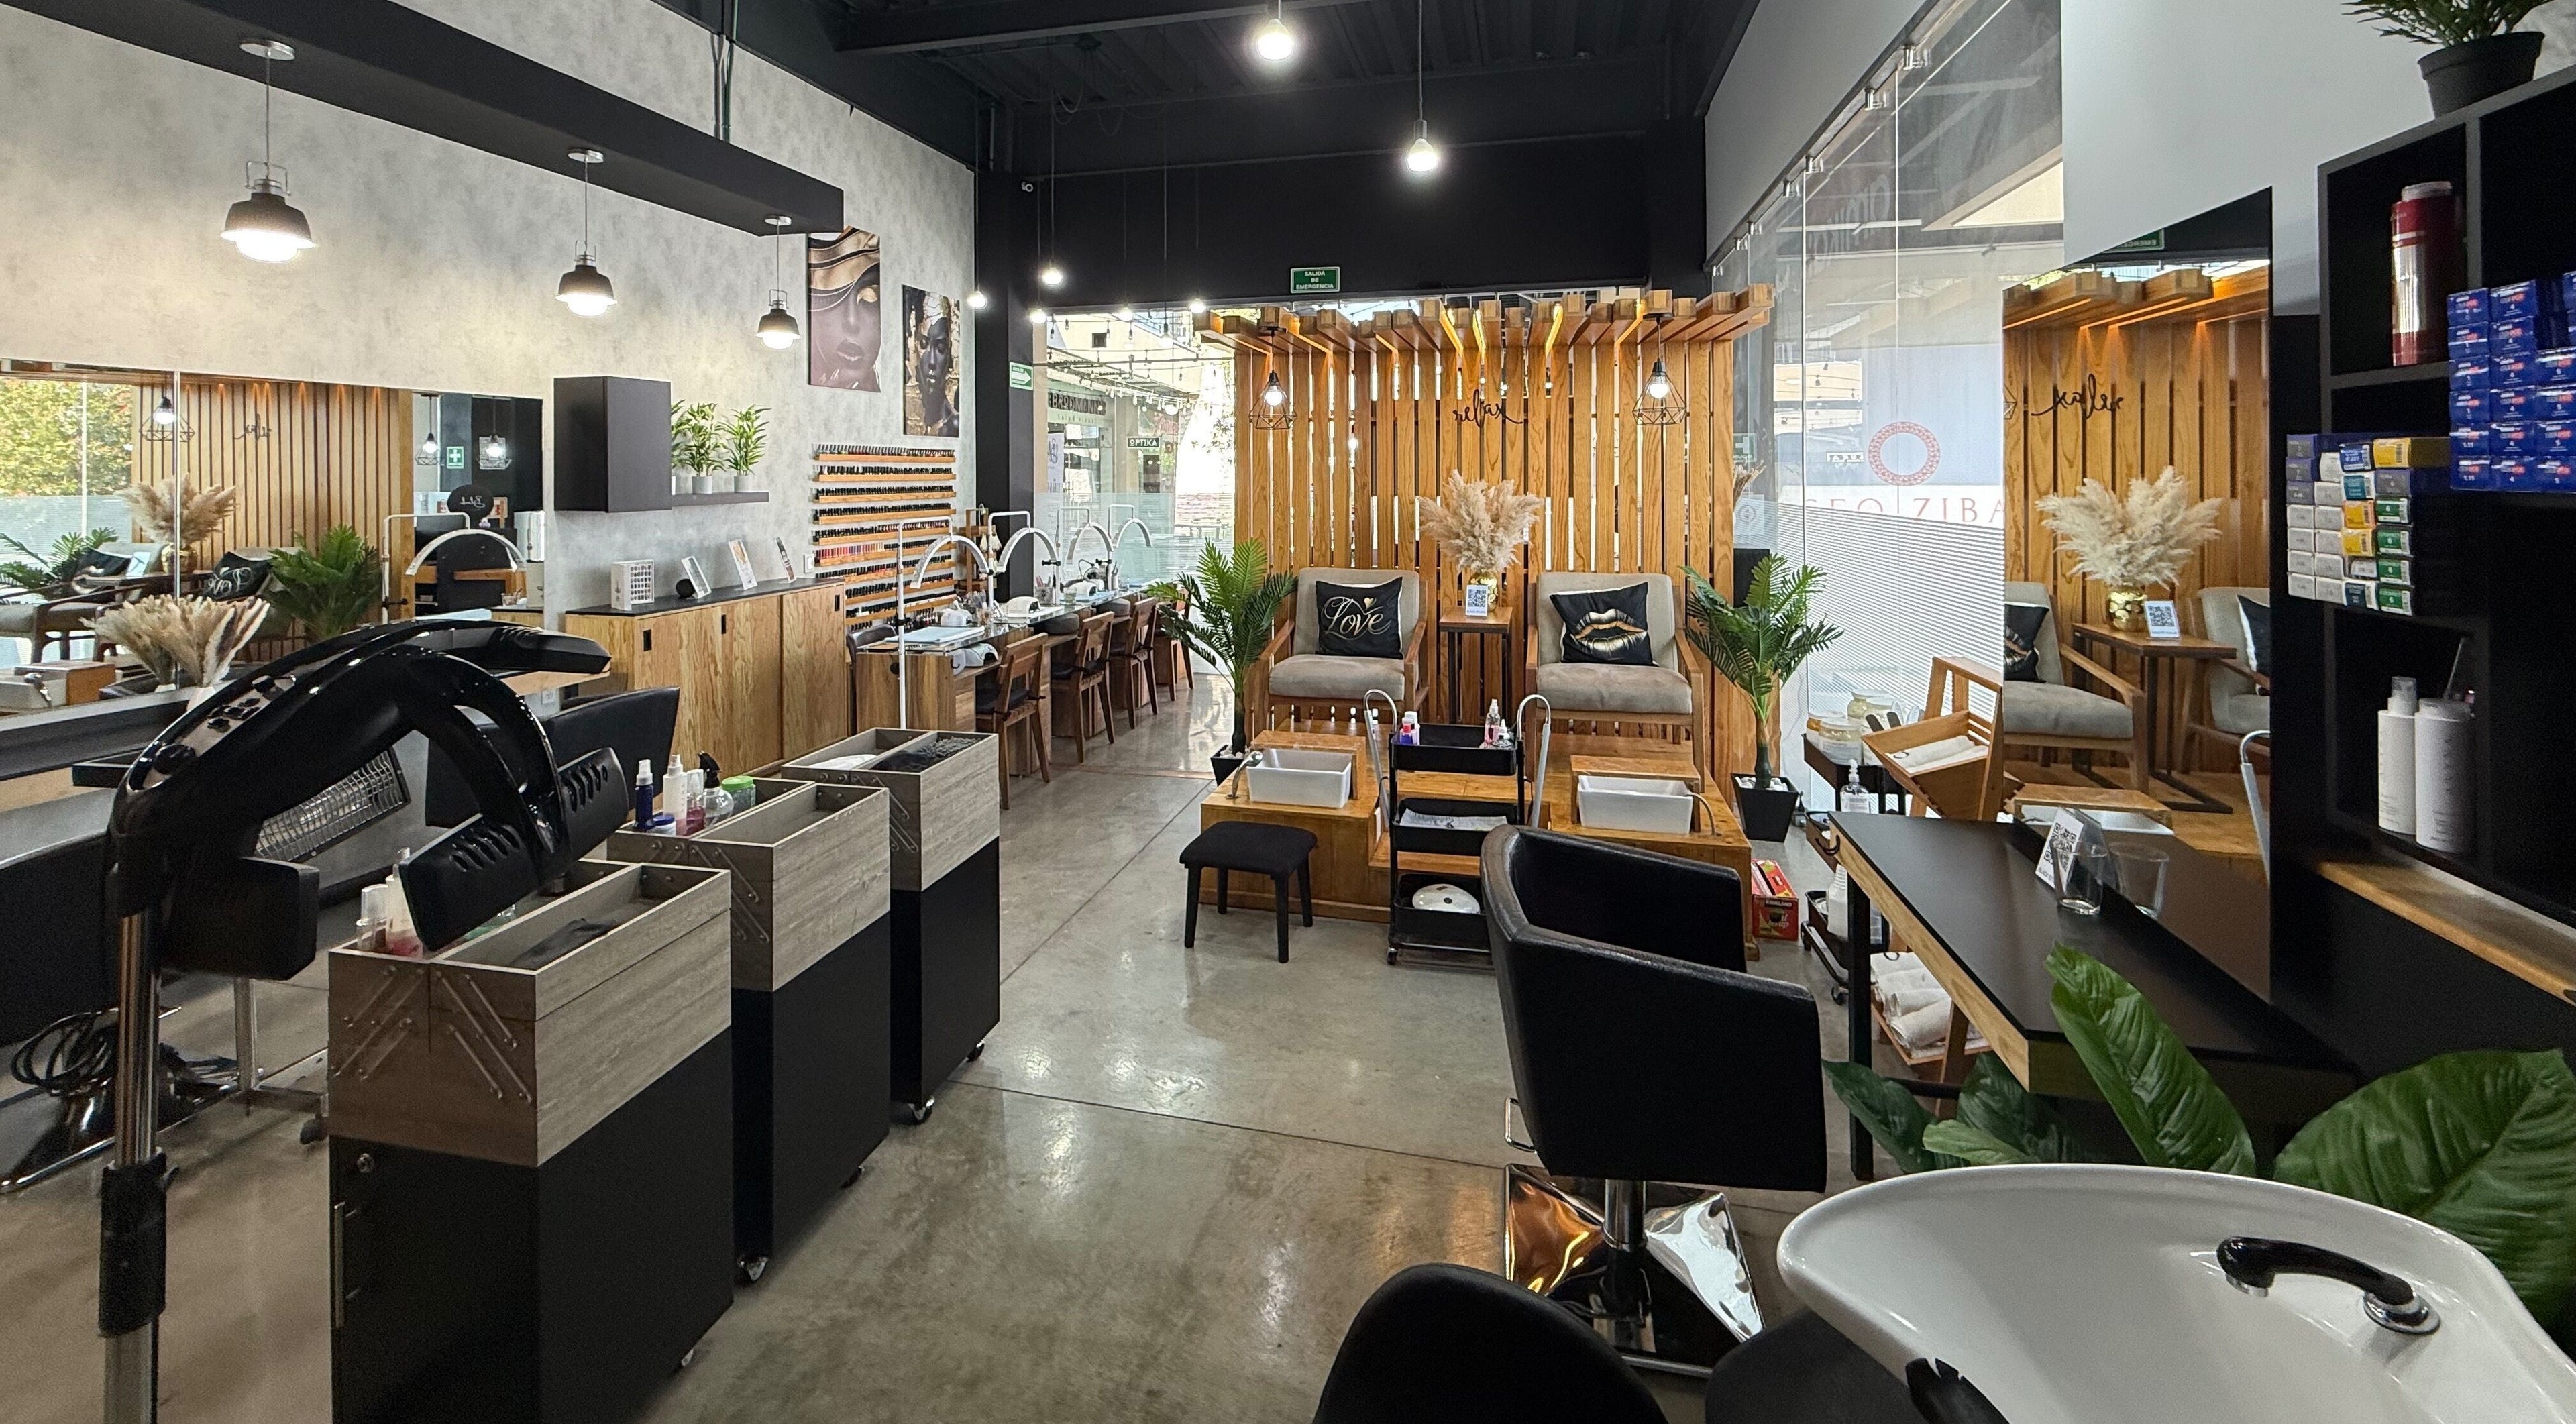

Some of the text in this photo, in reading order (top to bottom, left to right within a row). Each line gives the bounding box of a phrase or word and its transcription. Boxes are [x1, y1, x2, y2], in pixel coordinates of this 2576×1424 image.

[1452, 388, 1523, 428] relax
[1129, 439, 1157, 447] OPTIKA
[1321, 596, 1392, 640] Love
